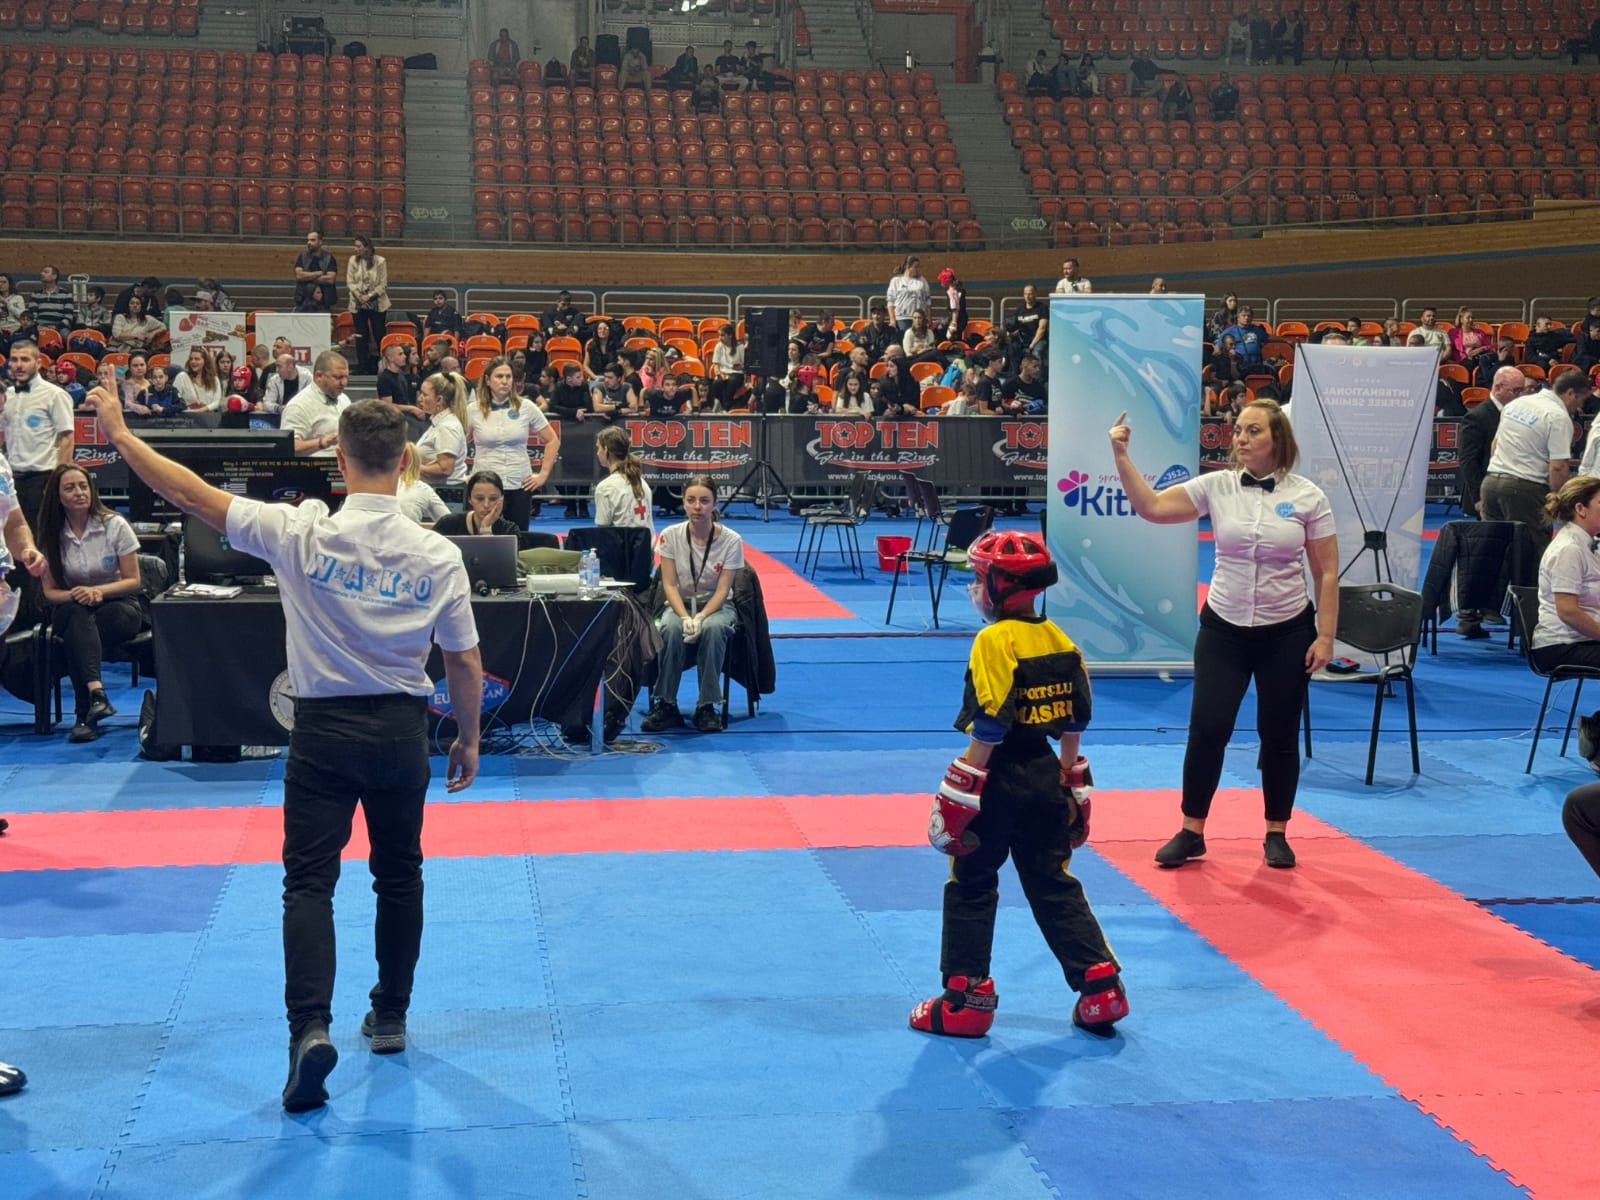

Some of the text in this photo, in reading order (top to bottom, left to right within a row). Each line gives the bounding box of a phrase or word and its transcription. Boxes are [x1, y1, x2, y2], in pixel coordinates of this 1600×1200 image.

[625, 420, 752, 448] TOP TEN
[814, 421, 939, 449] TOP TEN
[74, 448, 122, 464] Ring.
[663, 451, 677, 461] in
[682, 450, 704, 461] the
[709, 451, 752, 465] Ring.
[814, 451, 940, 466] Get in the Ring.
[1001, 451, 1031, 466] Get
[1080, 485, 1138, 517] Kit
